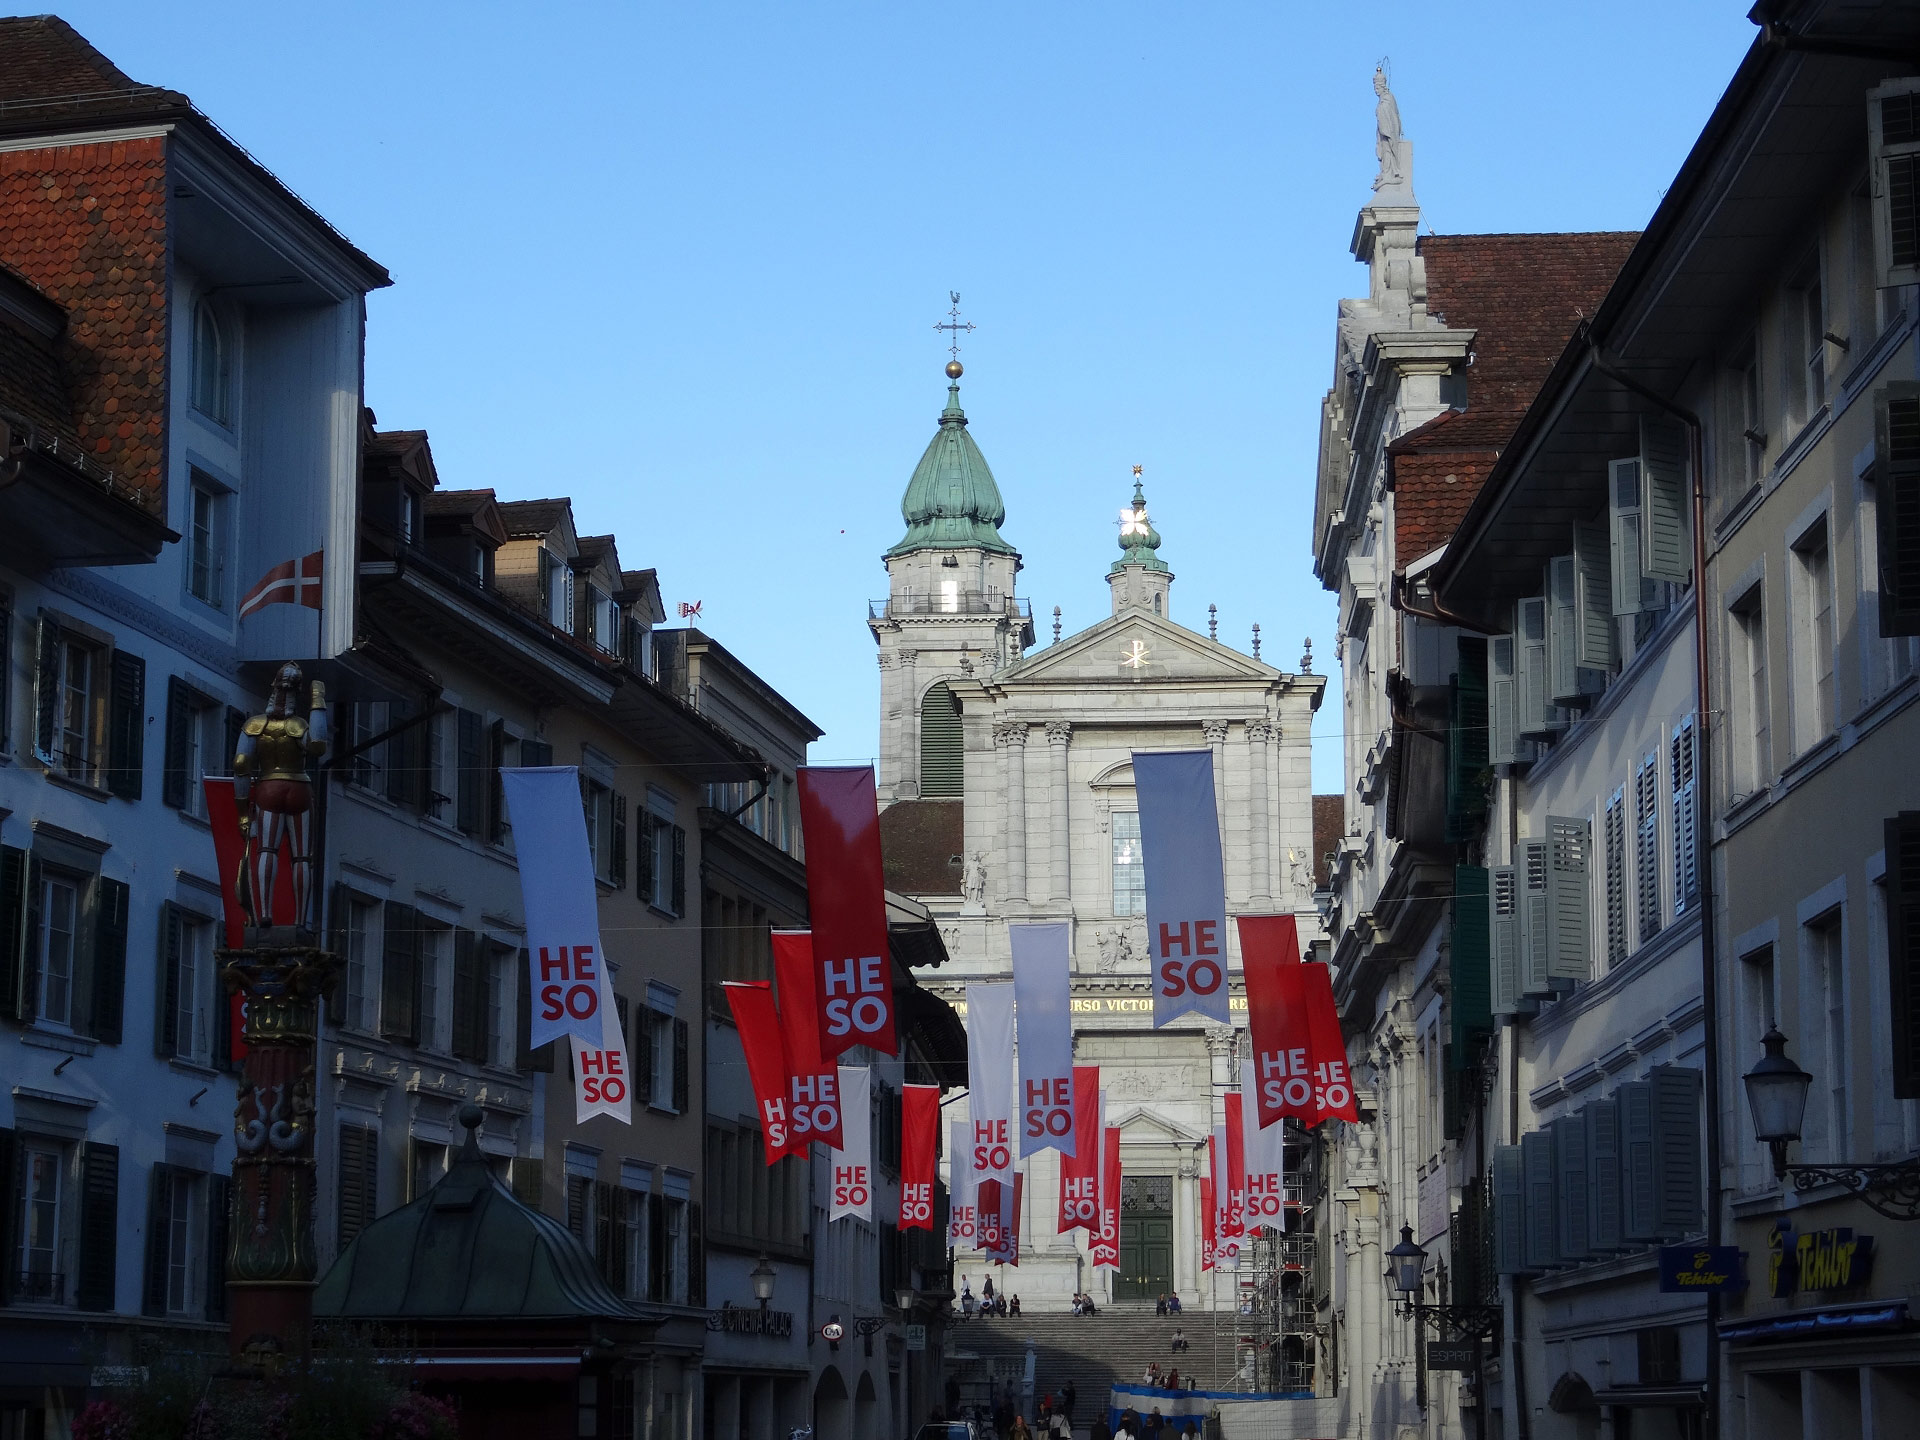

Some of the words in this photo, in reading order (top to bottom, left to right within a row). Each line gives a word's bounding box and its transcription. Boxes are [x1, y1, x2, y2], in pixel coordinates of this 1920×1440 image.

[1159, 920, 1217, 957] HE
[540, 945, 595, 982] HE
[823, 957, 884, 995] HE
[1161, 960, 1222, 997] SO
[541, 984, 598, 1020] SO
[825, 996, 887, 1035] SO
[580, 1050, 623, 1075] HE
[1261, 1048, 1308, 1078] HE
[581, 1077, 625, 1103] SO
[791, 1075, 835, 1103] HE
[1026, 1078, 1069, 1106] HE
[1264, 1078, 1311, 1108] SO
[763, 1097, 785, 1121] H
[791, 1104, 838, 1132] SO
[975, 1119, 1008, 1143] HE
[1025, 1109, 1072, 1137] SO
[768, 1123, 787, 1148] S
[974, 1145, 1010, 1170] SO
[835, 1165, 867, 1185] HE
[1248, 1173, 1278, 1194] HE
[835, 1186, 868, 1206] SO
[902, 1183, 931, 1202] HE
[1065, 1177, 1094, 1198] HE
[1230, 1189, 1243, 1208] H
[902, 1202, 930, 1220] SO
[952, 1206, 974, 1221] HE
[1063, 1200, 1095, 1220] SO
[1230, 1208, 1244, 1225] S
[1248, 1195, 1280, 1216] SO
[951, 1223, 975, 1237] SO
[978, 1213, 998, 1227] HE
[977, 1228, 998, 1242] SO
[1797, 1228, 1857, 1291] Tchibo
[1675, 1272, 1728, 1286] Tchibo
[824, 1327, 840, 1336] C&A
[1430, 1350, 1474, 1362] ESPRIT
